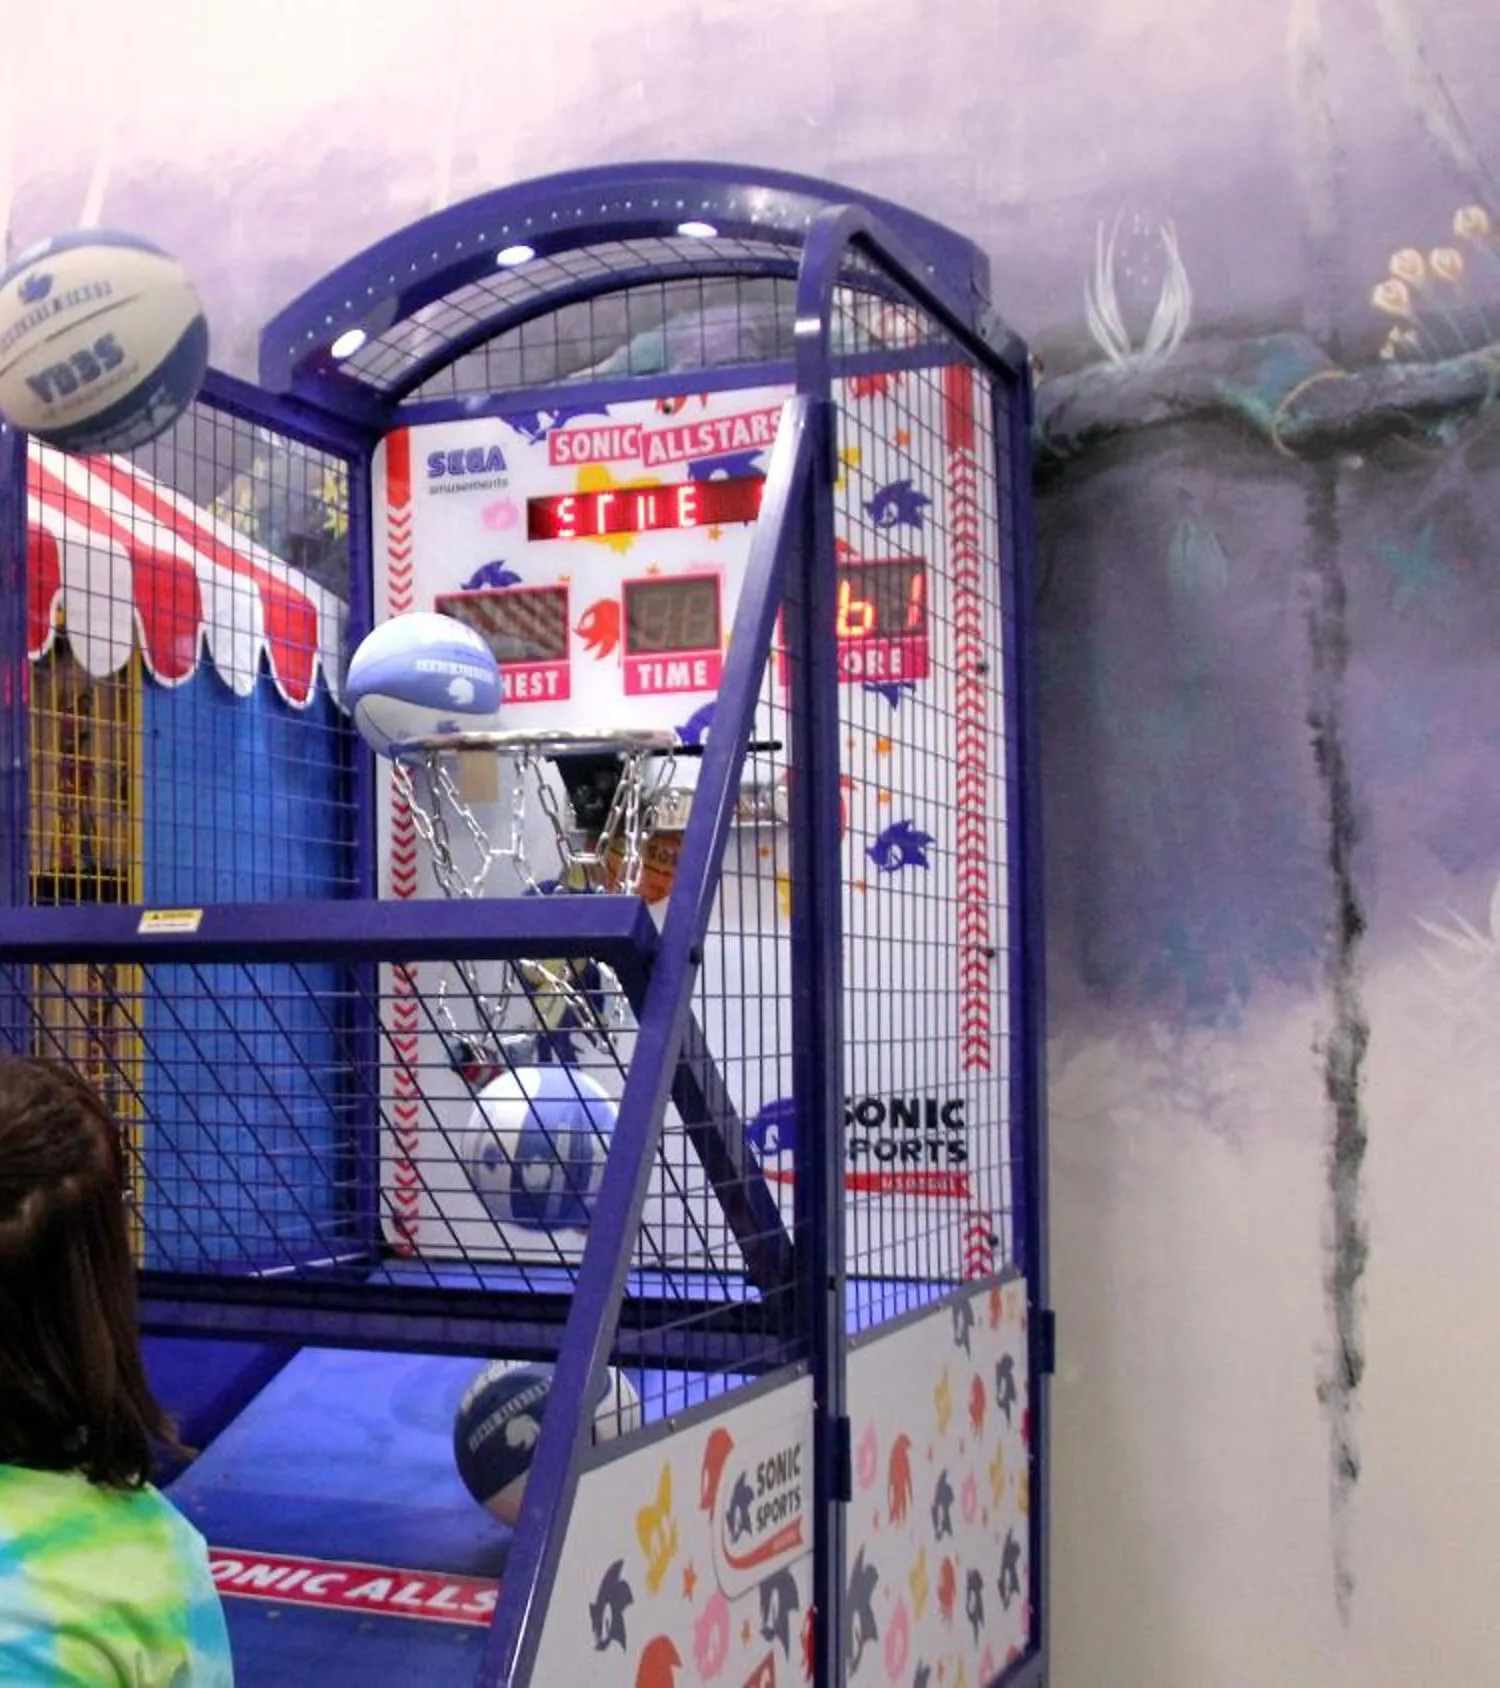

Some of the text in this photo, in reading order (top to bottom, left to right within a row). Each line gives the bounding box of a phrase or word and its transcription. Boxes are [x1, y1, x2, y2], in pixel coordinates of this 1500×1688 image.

[555, 409, 781, 464] SONIC ALLSTARS
[427, 445, 507, 478] SEGA
[637, 661, 707, 689] TIME
[842, 648, 901, 675] ORE
[501, 671, 559, 698] HEST
[849, 1138, 968, 1163] PORTS
[756, 1443, 801, 1498] SONIC
[756, 1486, 802, 1534] SPORTS
[209, 1560, 498, 1612] ONIC ALLS
